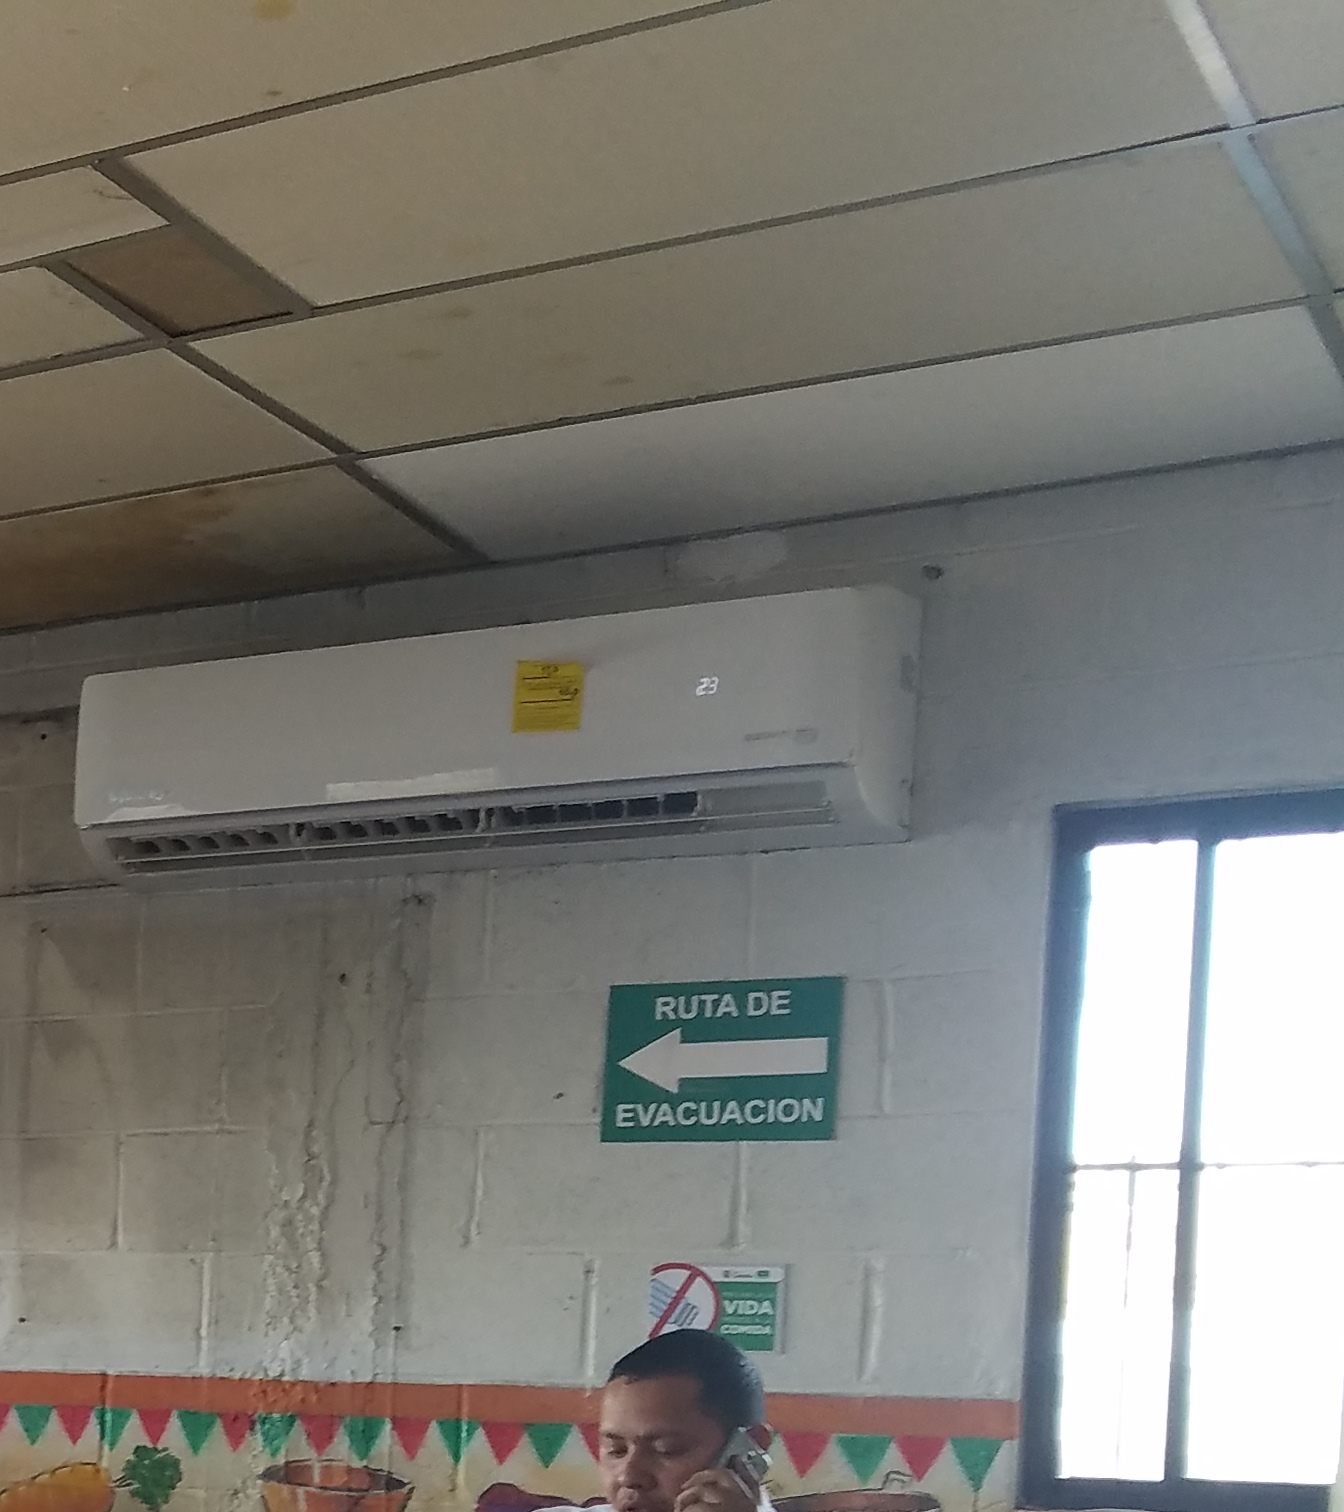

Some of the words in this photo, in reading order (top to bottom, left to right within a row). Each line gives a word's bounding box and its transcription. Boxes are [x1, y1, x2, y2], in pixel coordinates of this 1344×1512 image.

[696, 677, 719, 696] 23
[655, 993, 739, 1020] RUTA
[746, 990, 792, 1016] DE
[615, 1098, 826, 1127] EVACUACION
[722, 1299, 774, 1315] VIDA
